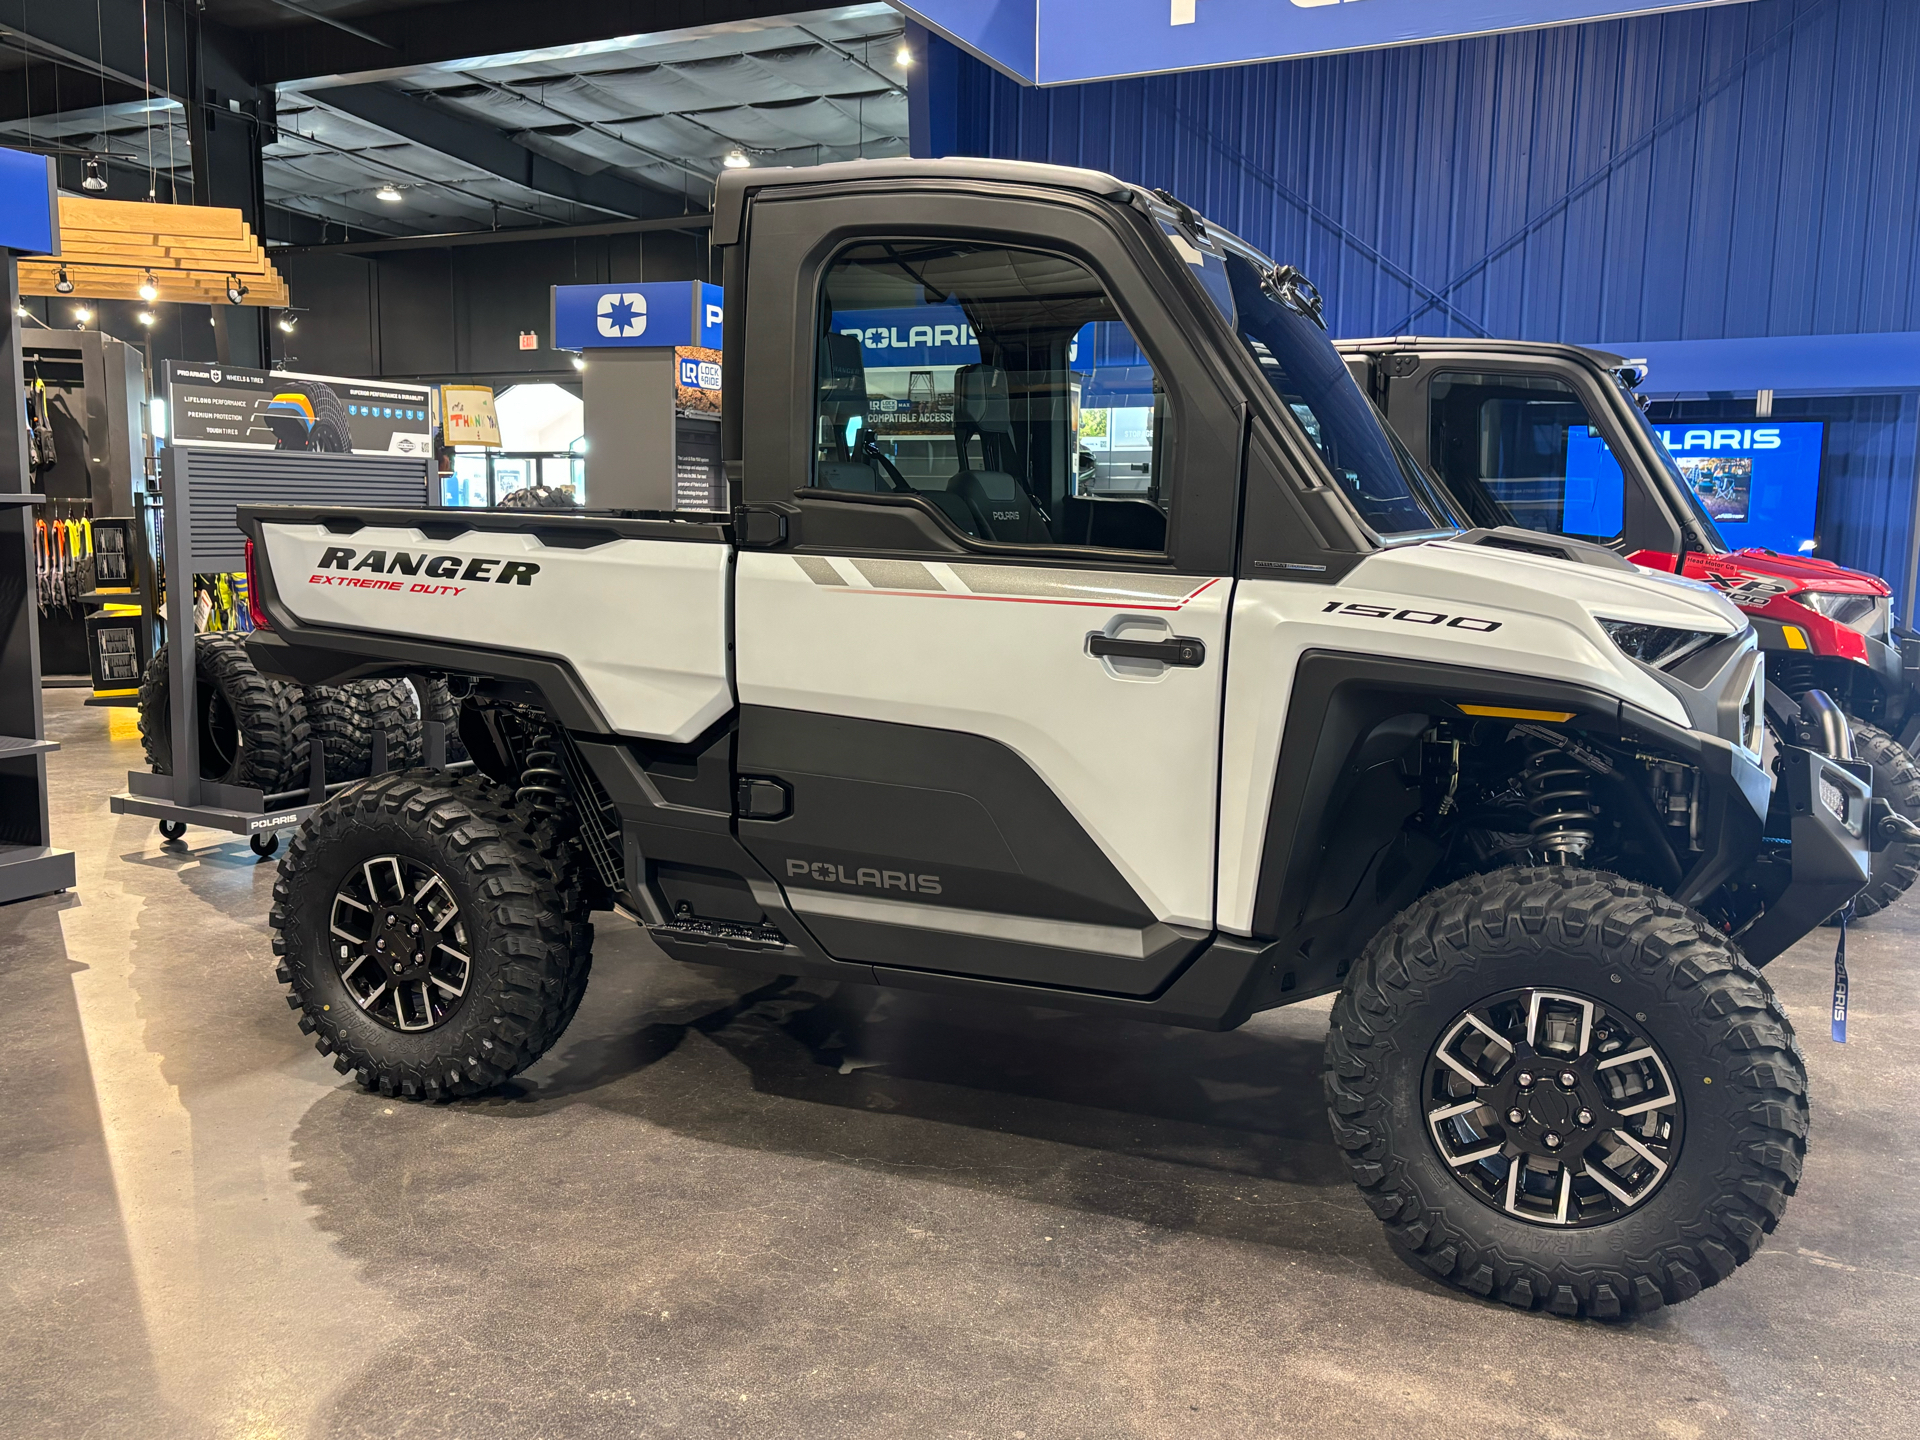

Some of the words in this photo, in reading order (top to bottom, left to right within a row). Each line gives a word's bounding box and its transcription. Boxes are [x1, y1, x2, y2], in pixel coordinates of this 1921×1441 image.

[522, 335, 535, 348] EXIT
[226, 374, 246, 382] WHEELS
[682, 362, 698, 384] LR
[700, 365, 719, 377] LOCK
[184, 396, 212, 405] LIFELONG
[212, 397, 247, 407] PERFORMANCE
[349, 388, 370, 397] SUPERIOR
[369, 390, 398, 400] PERFORMANCE
[401, 394, 425, 402] DURABILITY
[187, 411, 213, 419] PREMIUM
[213, 412, 243, 421] PROTECTION
[450, 413, 486, 428] THANK
[867, 413, 918, 423] COMPATIBLE
[222, 427, 239, 435] TIRES
[1655, 428, 1782, 450] LARIS
[992, 511, 1020, 520] POLARIS
[317, 547, 541, 586] RANGER
[1687, 557, 1704, 565] Head
[1705, 560, 1725, 568] Motor
[308, 574, 404, 591] EXTREME
[409, 583, 467, 597] DUTY
[1698, 571, 1788, 594] XP
[1321, 601, 1503, 633] 1500
[250, 813, 298, 831] POLARIS
[786, 858, 943, 895] POLARIS
[1834, 951, 1849, 1022] POLARIS
